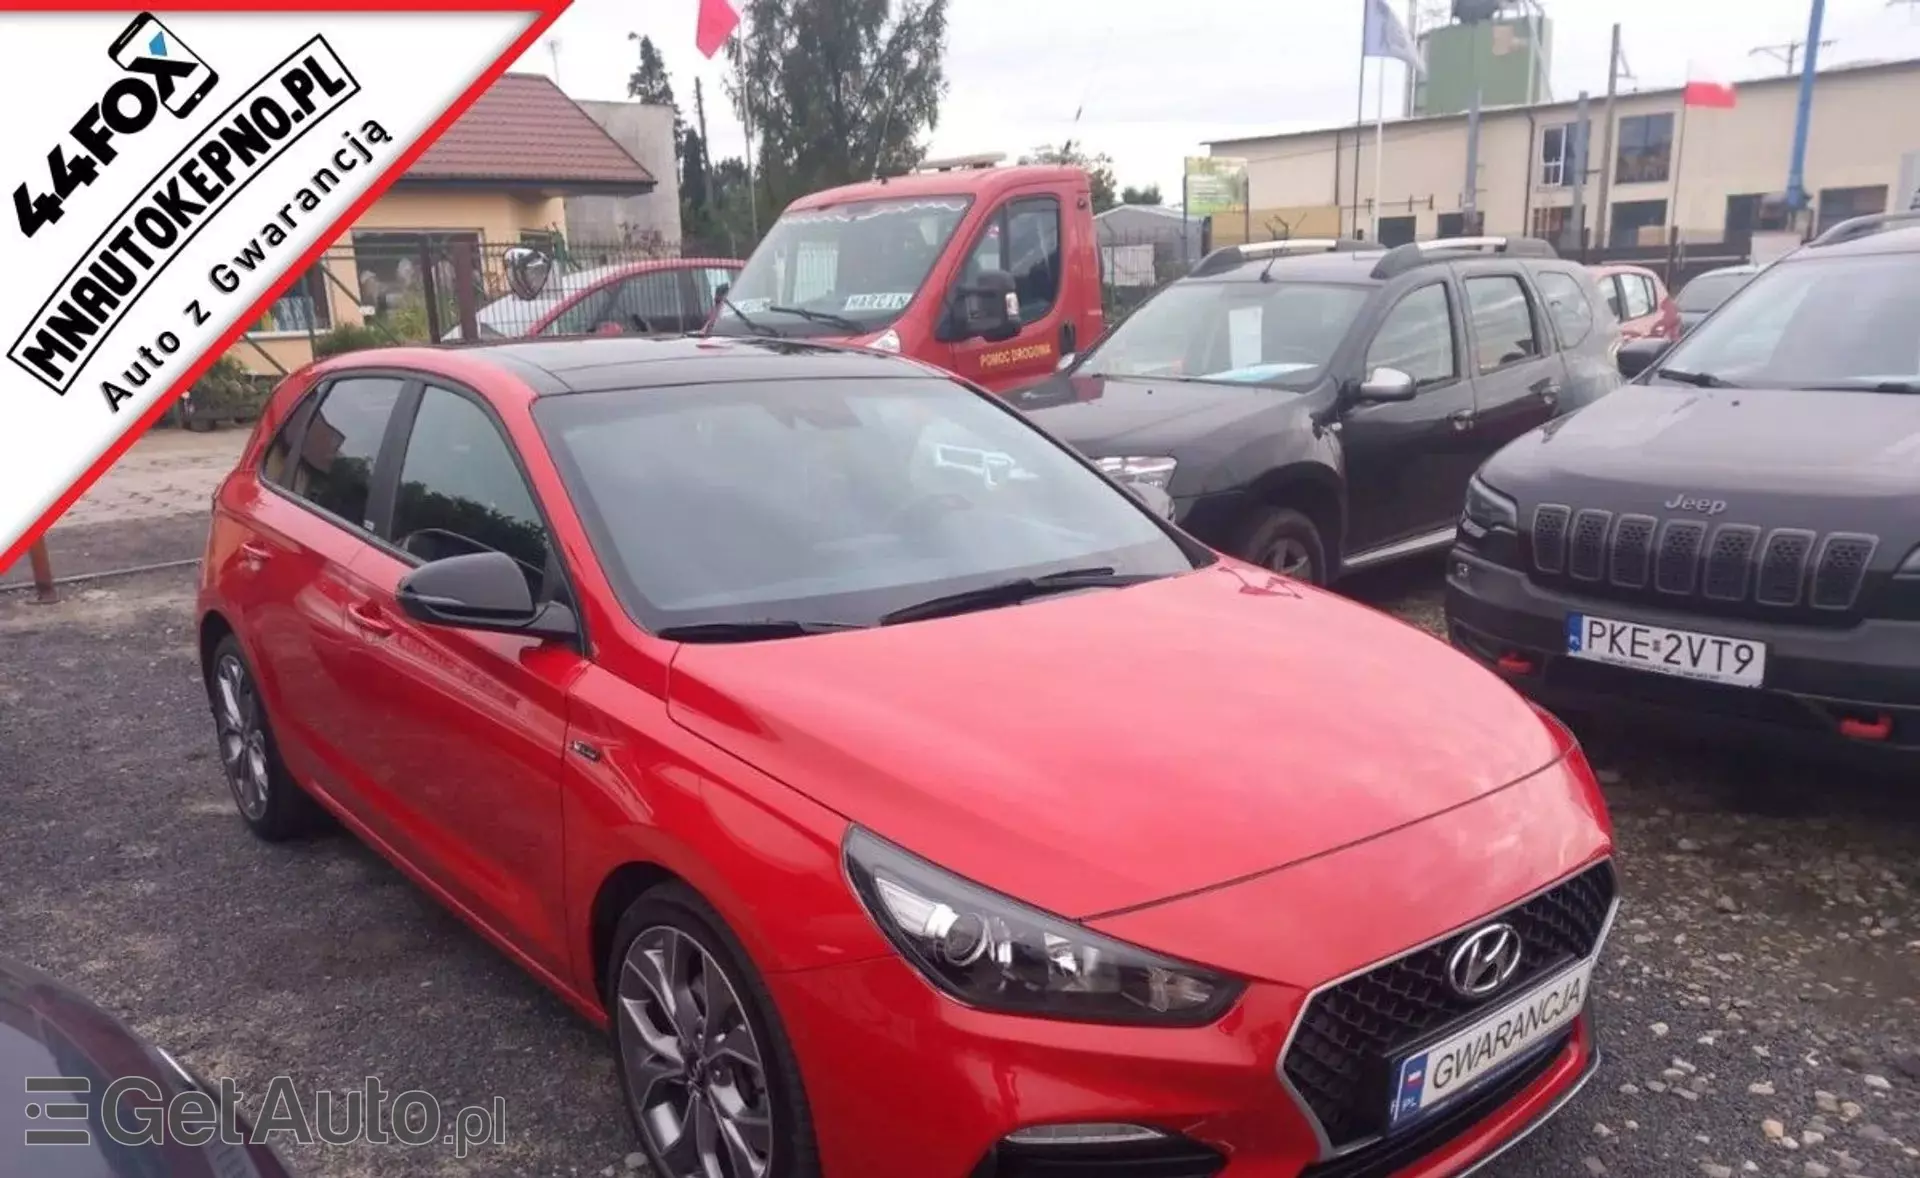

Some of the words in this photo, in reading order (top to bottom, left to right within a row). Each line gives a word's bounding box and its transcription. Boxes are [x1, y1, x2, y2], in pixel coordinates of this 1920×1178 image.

[979, 350, 1010, 368] POMOC
[1664, 494, 1727, 515] Jeep
[1588, 619, 1650, 660] PKE
[1663, 633, 1755, 675] 2VT9
[1432, 979, 1582, 1091] GWARANCJA
